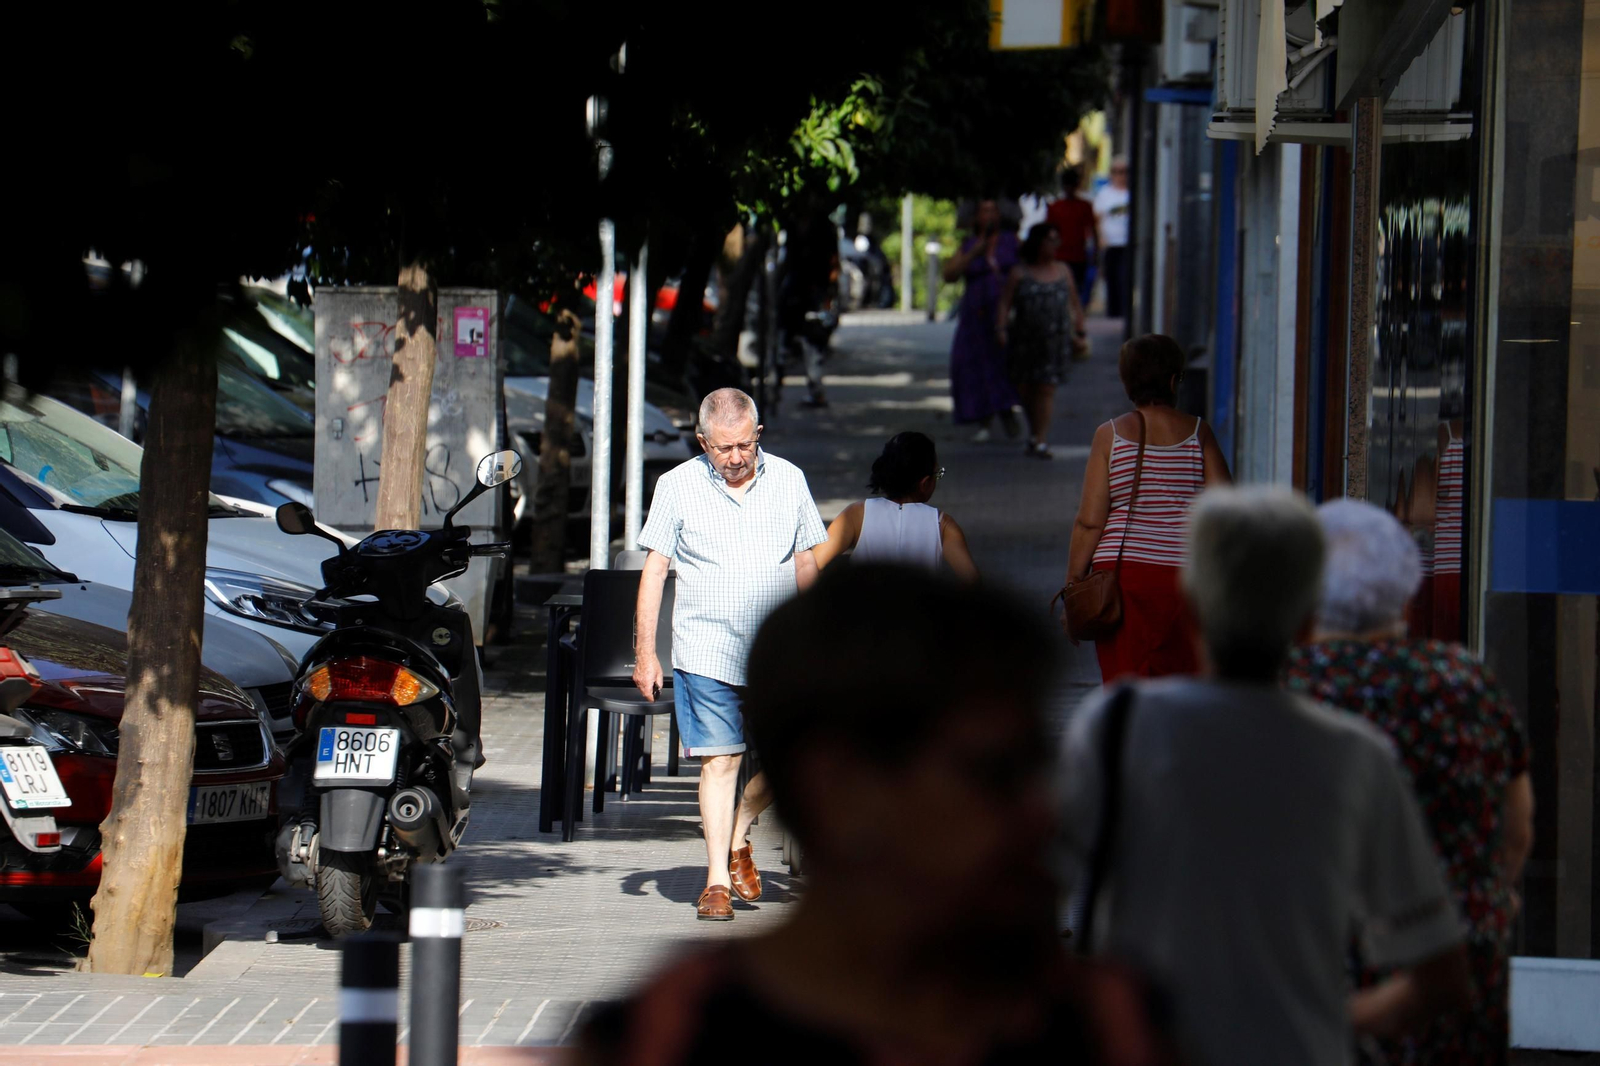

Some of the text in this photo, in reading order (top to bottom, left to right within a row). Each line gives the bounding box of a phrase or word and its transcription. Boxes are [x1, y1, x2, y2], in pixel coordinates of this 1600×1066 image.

[337, 731, 390, 752] 8606
[6, 752, 47, 772] 8119
[322, 748, 330, 756] E
[335, 753, 376, 773] HNT
[14, 774, 47, 794] LRJ
[201, 790, 237, 819] 1807
[240, 786, 267, 815] KHT
